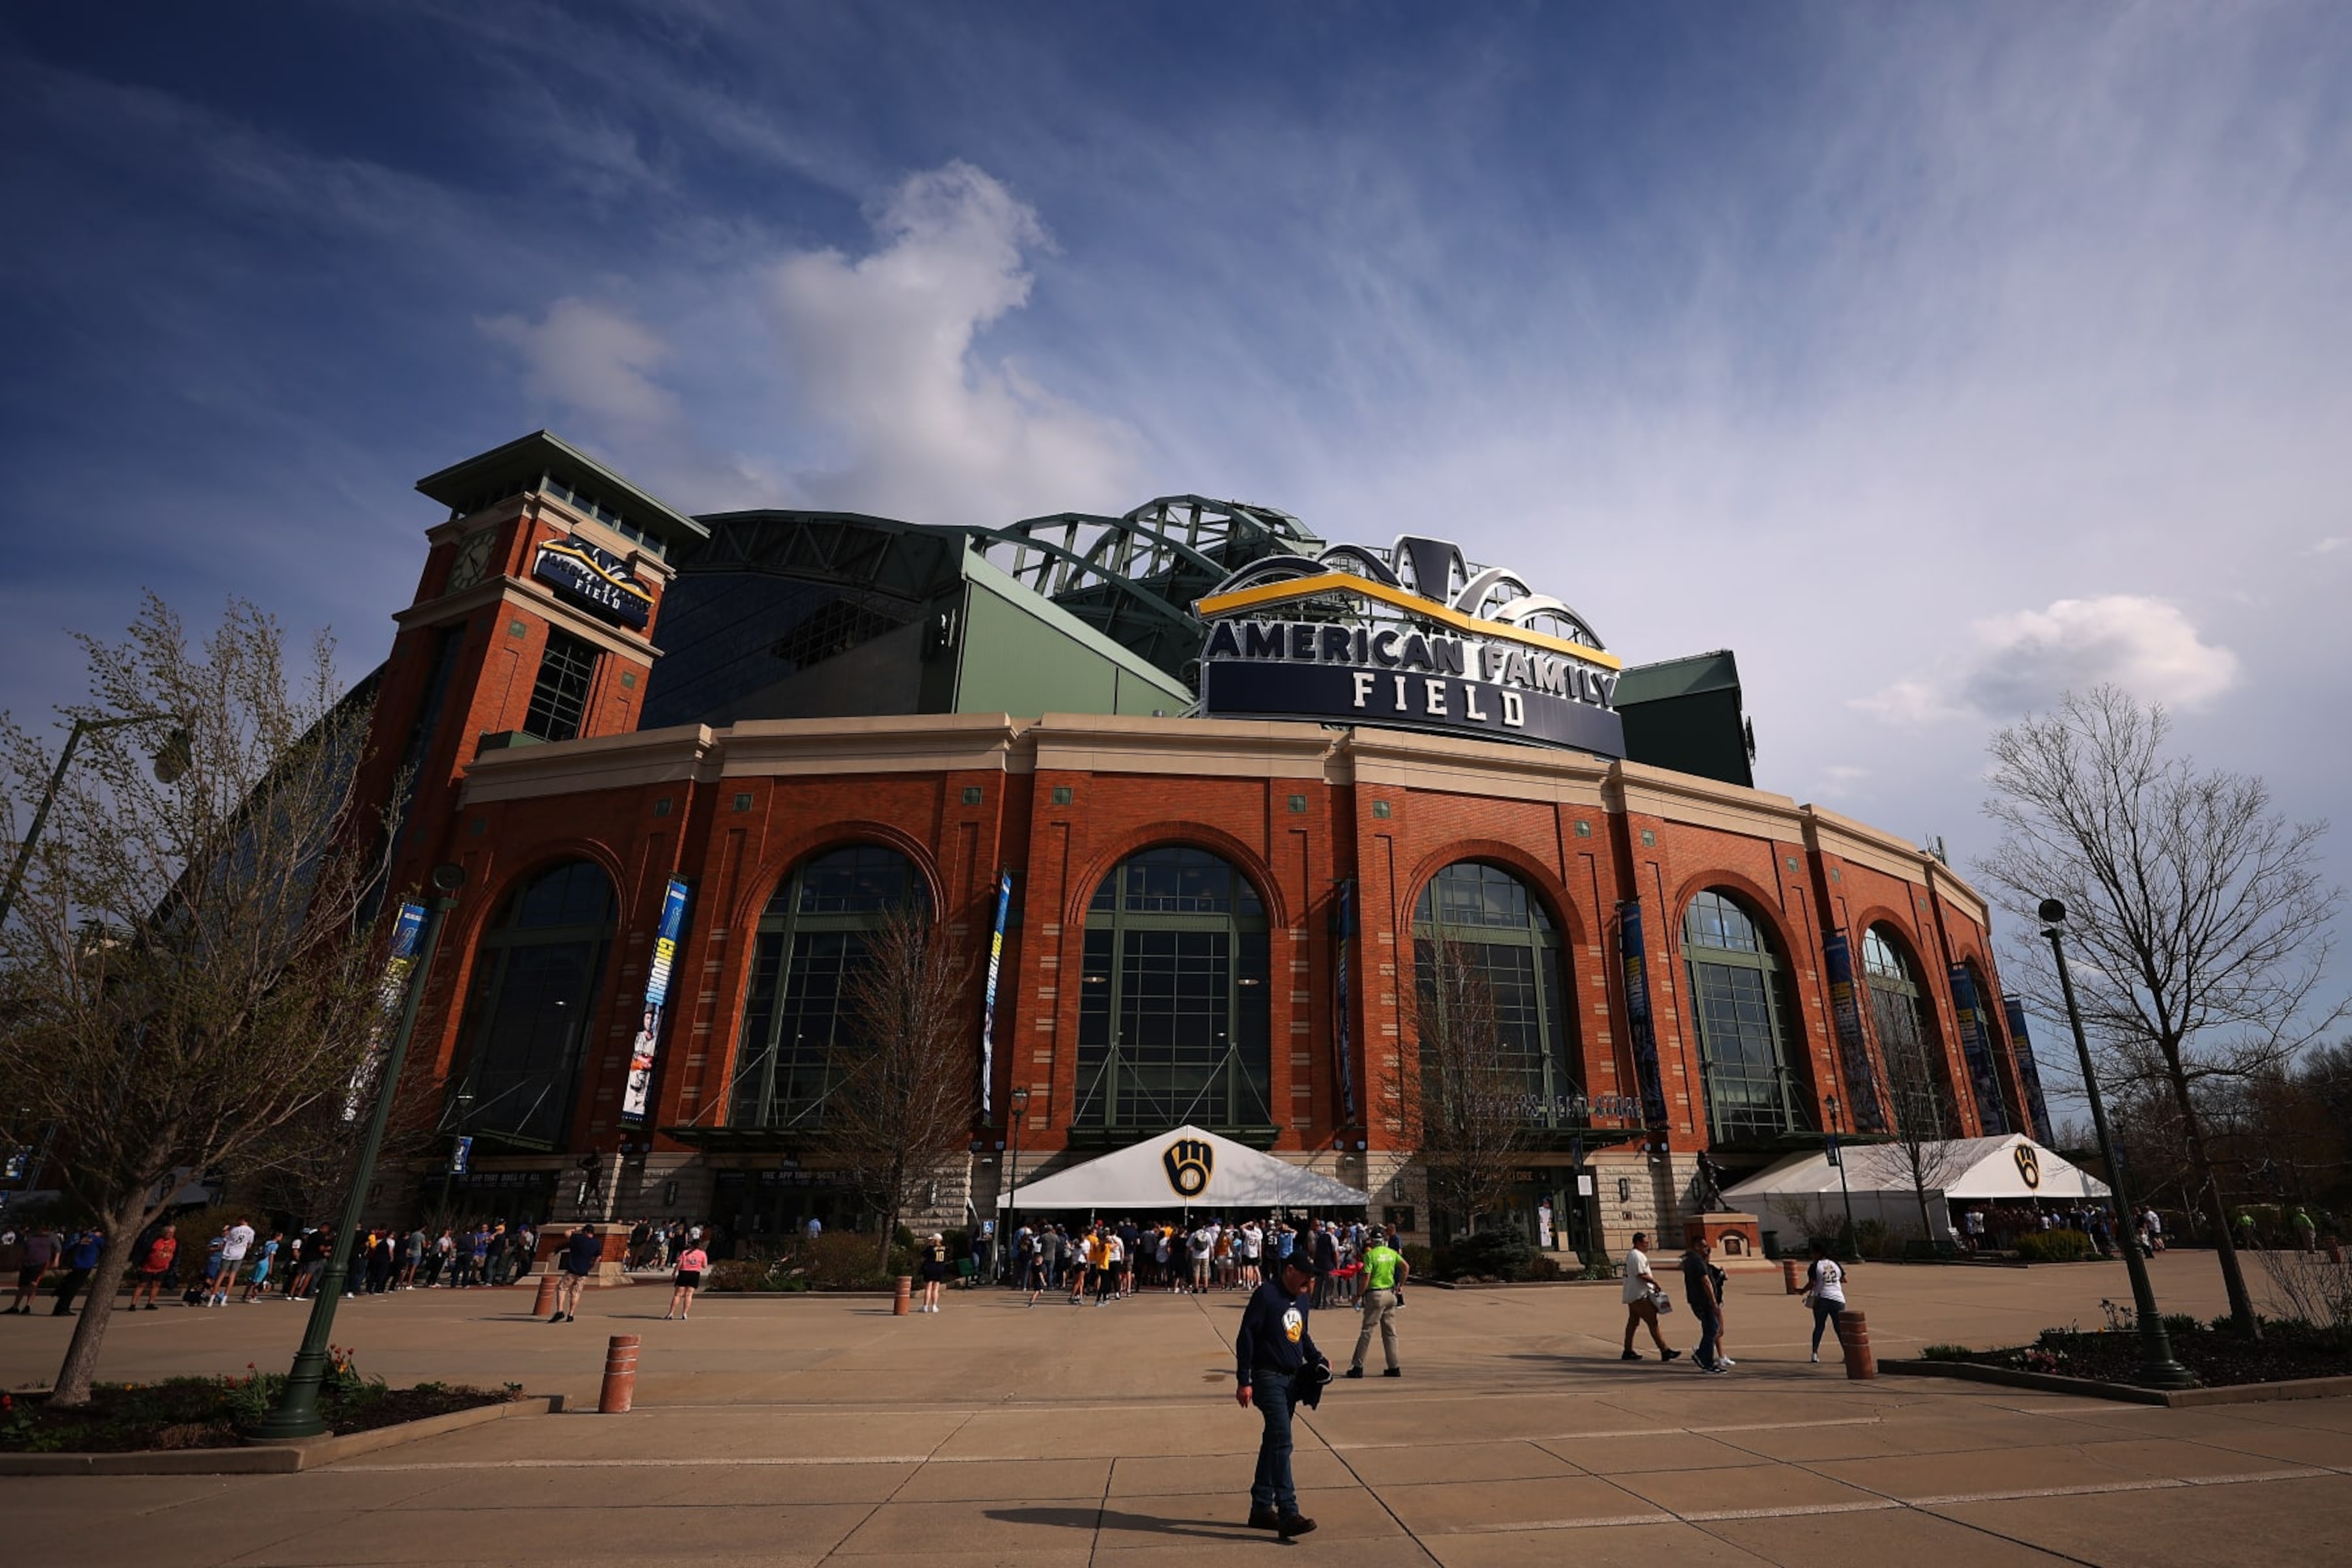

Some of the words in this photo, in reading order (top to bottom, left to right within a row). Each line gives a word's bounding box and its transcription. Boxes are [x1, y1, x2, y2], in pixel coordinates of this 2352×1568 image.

[574, 578, 621, 610] FIELD
[1207, 621, 1464, 673] AMERICAN
[1480, 645, 1617, 706] FAMILY
[1353, 672, 1524, 727] FIELD
[1625, 956, 1646, 1019] HOSKINS
[1594, 1096, 1642, 1118] STORE
[236, 1235, 244, 1244] 8
[935, 1251, 945, 1262] 10
